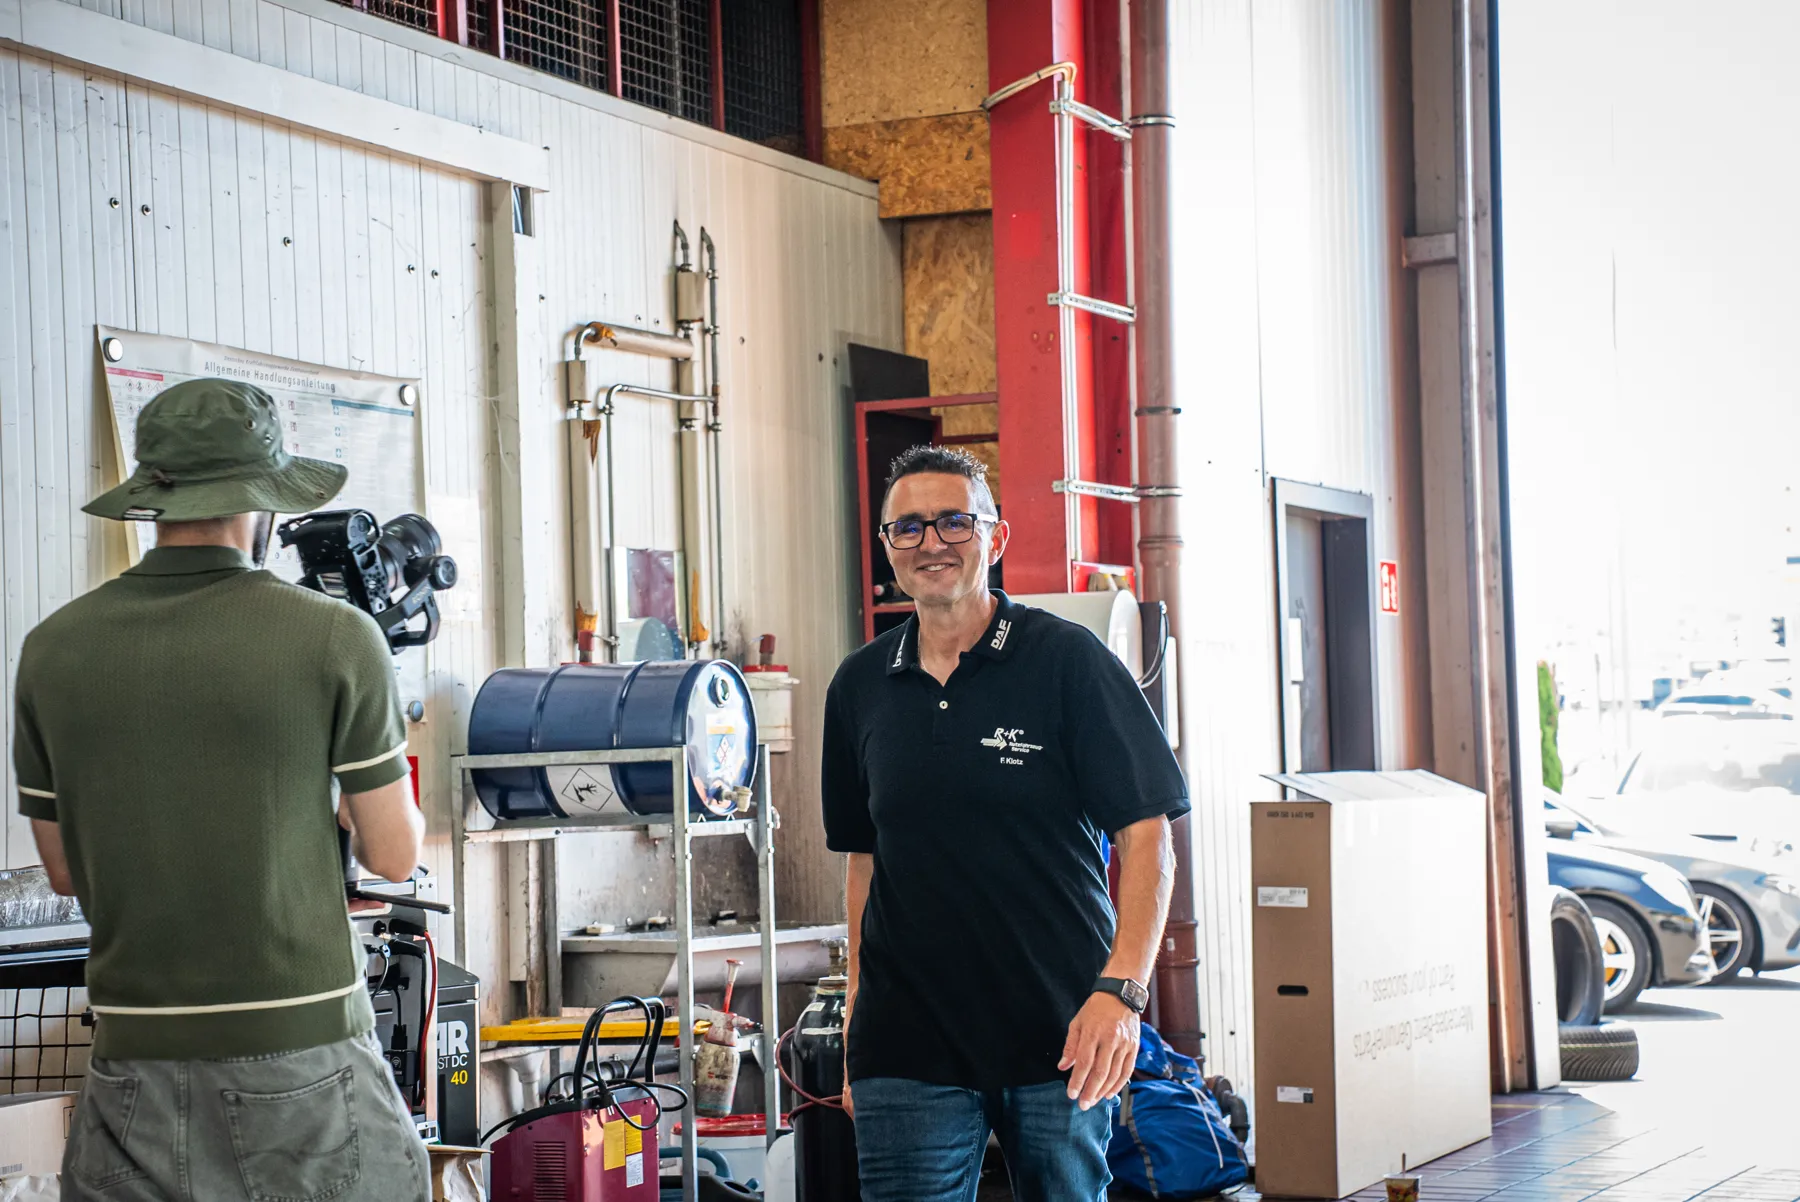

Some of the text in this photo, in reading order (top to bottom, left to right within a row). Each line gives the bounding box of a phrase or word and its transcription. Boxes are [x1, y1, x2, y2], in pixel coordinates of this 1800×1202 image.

[204, 361, 251, 379] Allgemeine
[254, 369, 336, 393] Handlungsanleitung
[990, 618, 1010, 650] DAF
[1006, 757, 1024, 766] Klotz
[1373, 972, 1408, 1002] success
[451, 1054, 468, 1068] DC
[450, 1069, 469, 1086] 40
